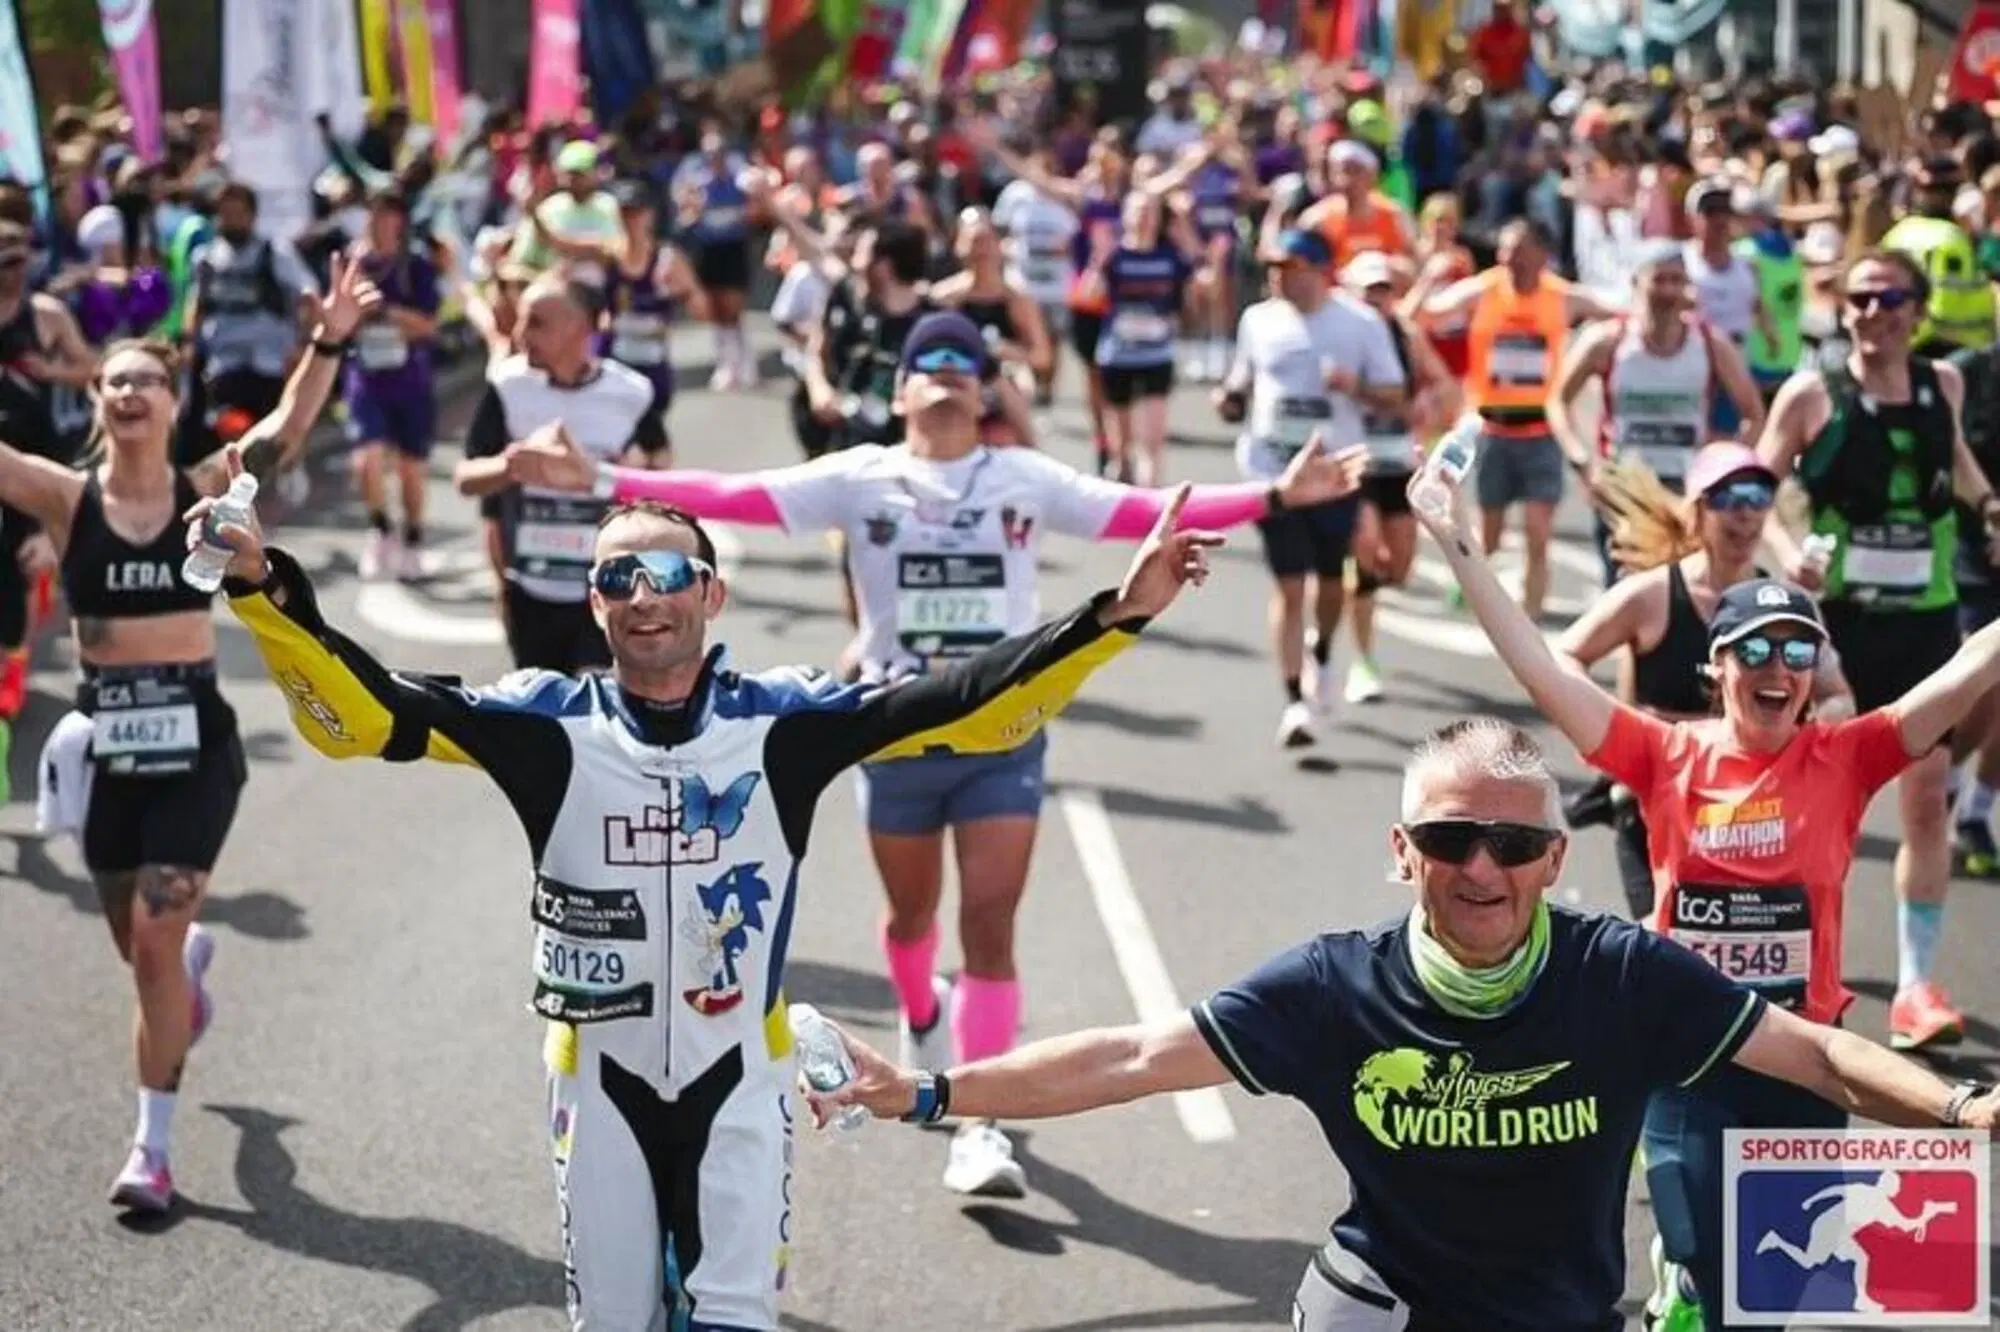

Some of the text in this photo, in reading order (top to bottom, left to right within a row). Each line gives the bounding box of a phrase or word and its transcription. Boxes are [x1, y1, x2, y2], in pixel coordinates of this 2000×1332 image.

[1689, 818, 1784, 854] MARATHON
[1677, 889, 1725, 924] tcs
[1730, 893, 1762, 903] TATA
[1730, 903, 1802, 914] CONSULTANCY
[543, 940, 625, 984] 50129
[1692, 942, 1788, 977] 1549
